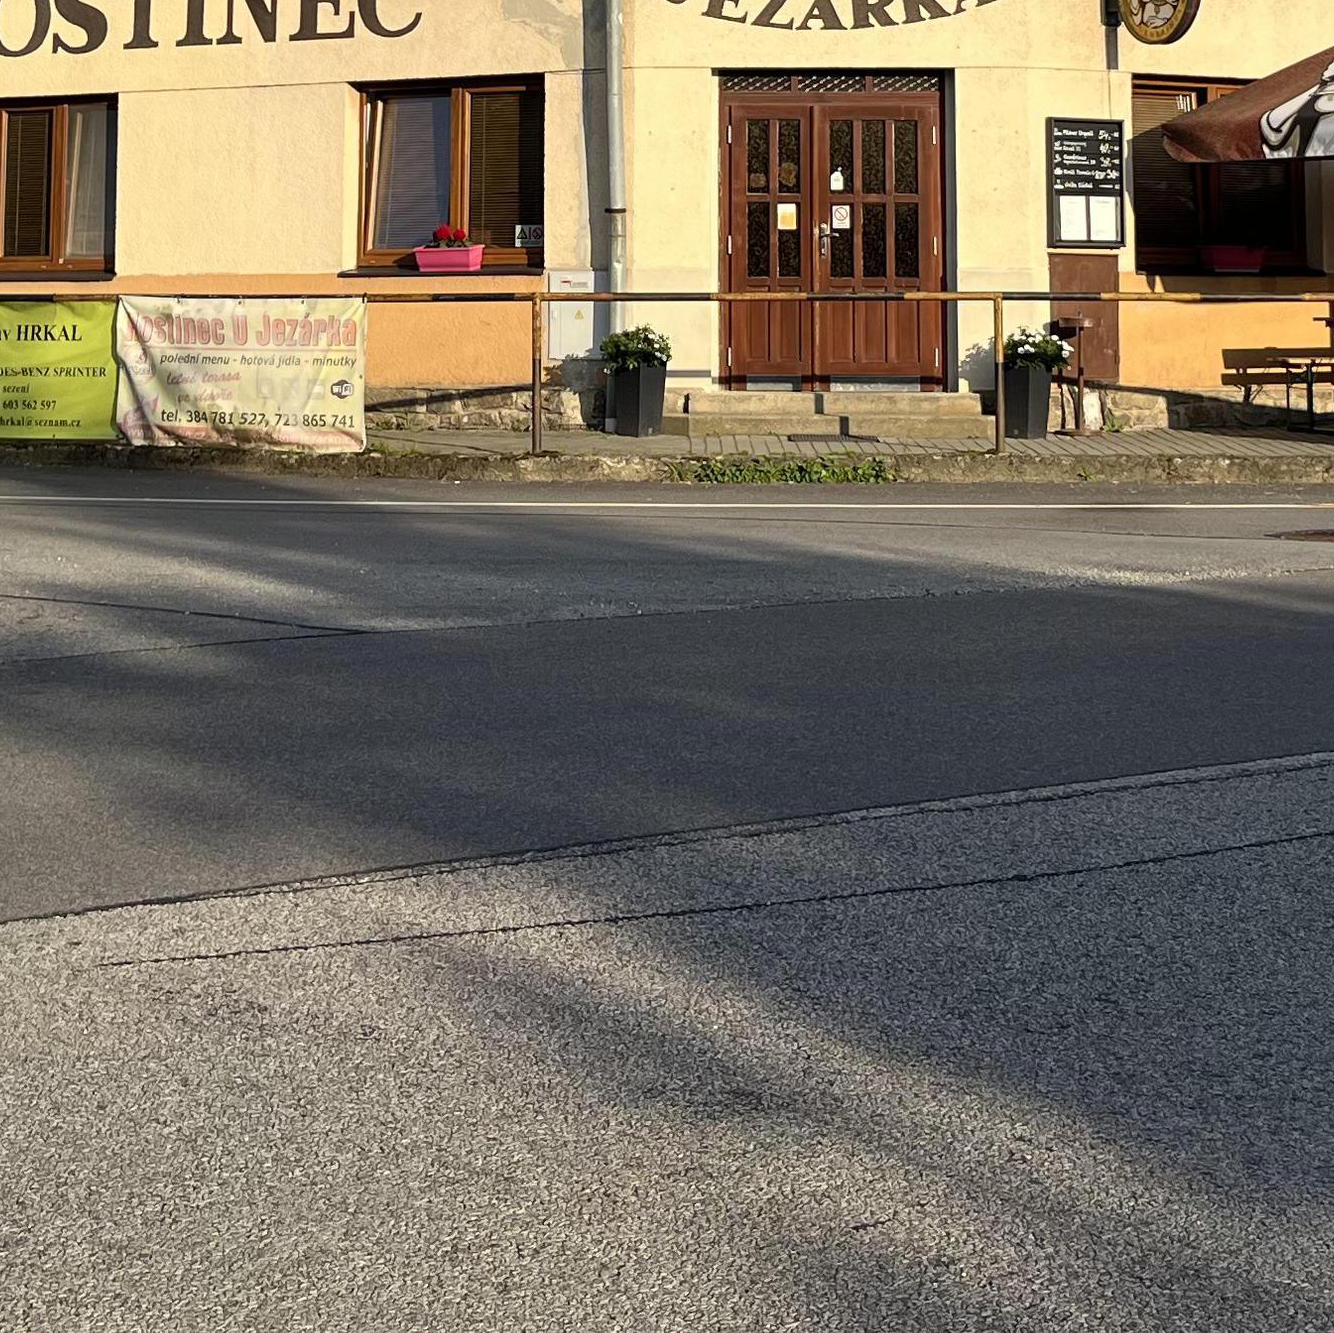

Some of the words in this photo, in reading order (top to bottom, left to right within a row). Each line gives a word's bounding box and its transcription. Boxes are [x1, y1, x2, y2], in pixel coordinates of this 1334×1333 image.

[17, 325, 82, 342] HRKAL
[232, 313, 248, 345] U
[257, 312, 357, 347] Jezárka
[160, 353, 200, 366] polední
[202, 356, 230, 365] menu
[240, 355, 273, 366] hotová
[276, 355, 300, 367] jídla
[312, 356, 357, 368] minutky
[53, 367, 107, 378] SPRINTER
[201, 371, 241, 385] terasa
[2, 383, 29, 394] sezení
[2, 400, 18, 410] 603
[21, 400, 37, 410] 562
[40, 400, 57, 410] 597
[161, 409, 181, 423] tel.
[187, 410, 207, 424] 384
[211, 411, 234, 426] 781
[240, 413, 269, 427] 527,
[274, 414, 298, 427] 723
[302, 415, 326, 427] 865
[332, 415, 355, 428] 741
